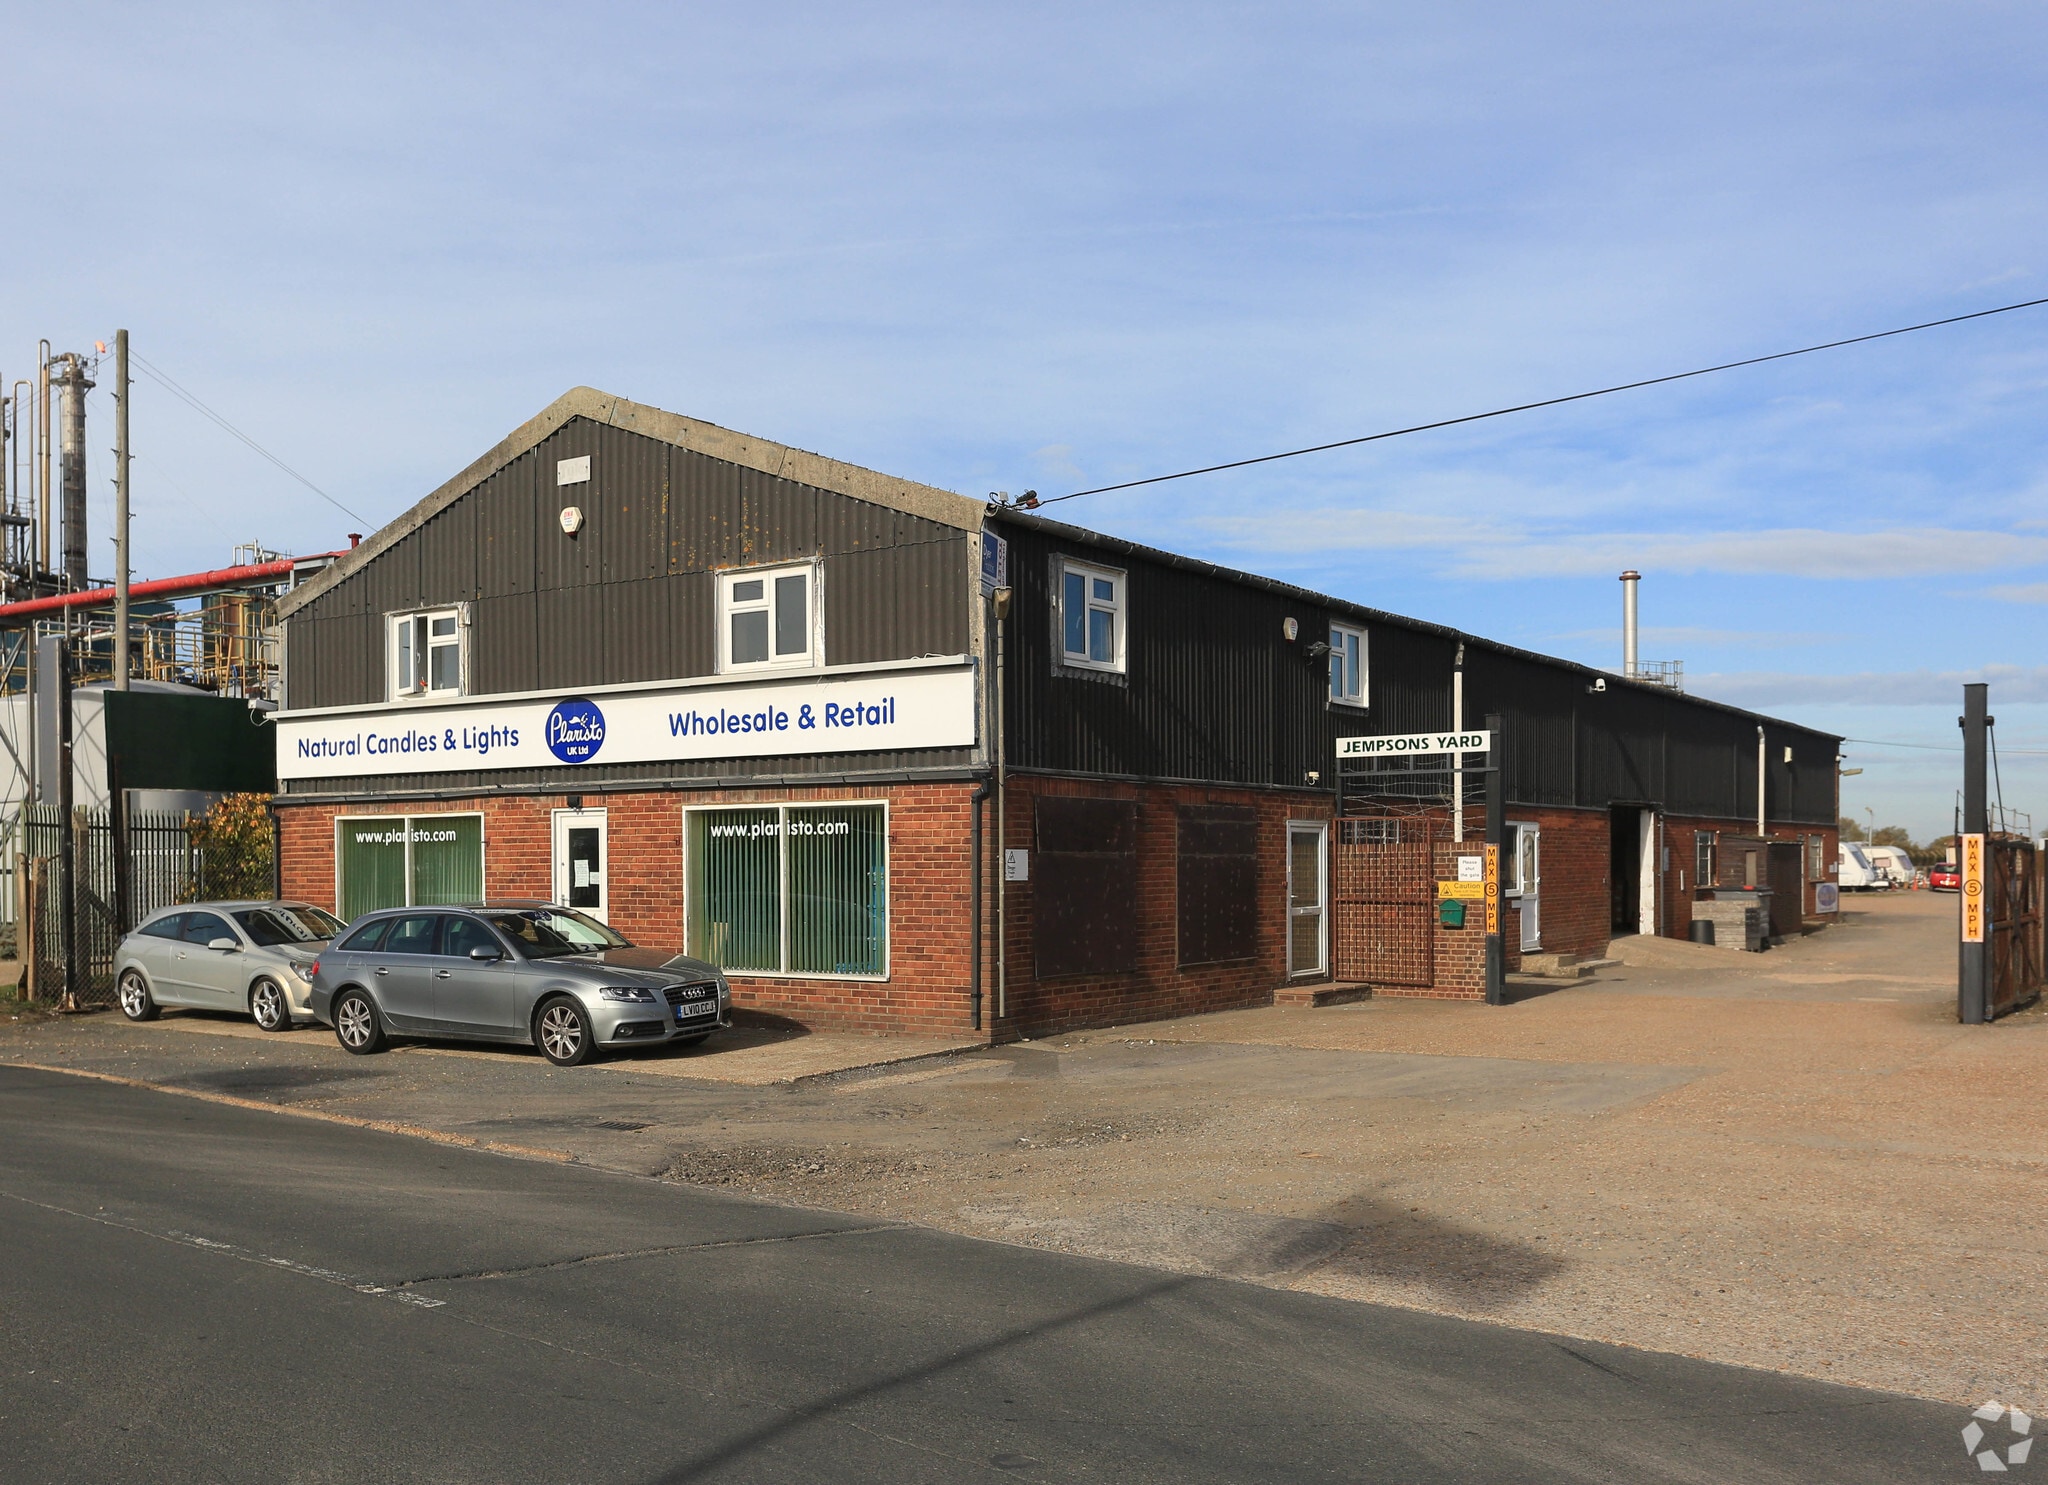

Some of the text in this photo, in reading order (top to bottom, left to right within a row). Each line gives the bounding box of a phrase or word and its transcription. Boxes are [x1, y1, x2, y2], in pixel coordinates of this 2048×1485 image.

[550, 712, 603, 746] Plaristo
[669, 697, 895, 737] Wholesale & Retail
[299, 725, 519, 758] Natural Candles & Lights
[567, 745, 589, 755] UK Ltd
[1343, 735, 1483, 753] JEMPSONS YARD
[1488, 849, 1497, 931] MAX 5 MPH
[1968, 840, 1978, 936] MAX 5 MPH
[700, 1002, 714, 1013] CCJ
